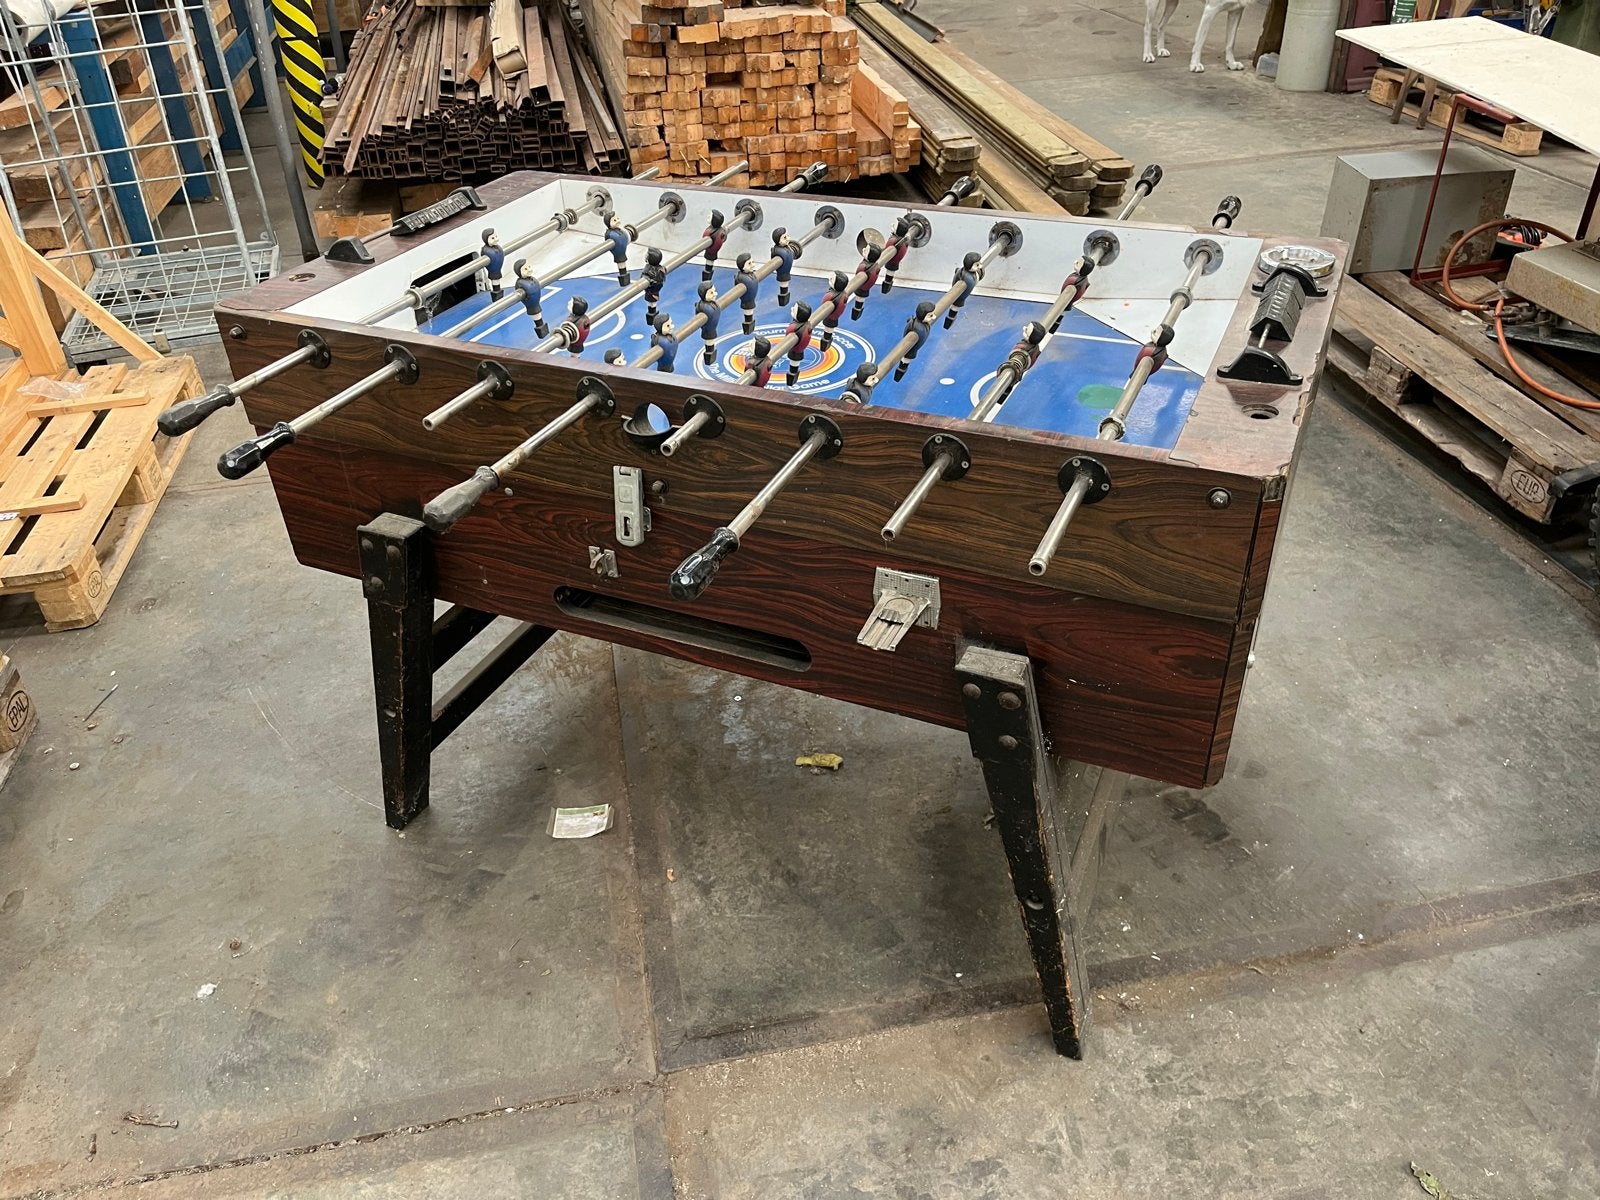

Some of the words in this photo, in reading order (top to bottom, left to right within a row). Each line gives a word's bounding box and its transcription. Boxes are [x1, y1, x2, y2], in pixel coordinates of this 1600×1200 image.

[788, 379, 830, 390] Game
[1517, 474, 1540, 496] EUR
[9, 696, 28, 728] EPAL
